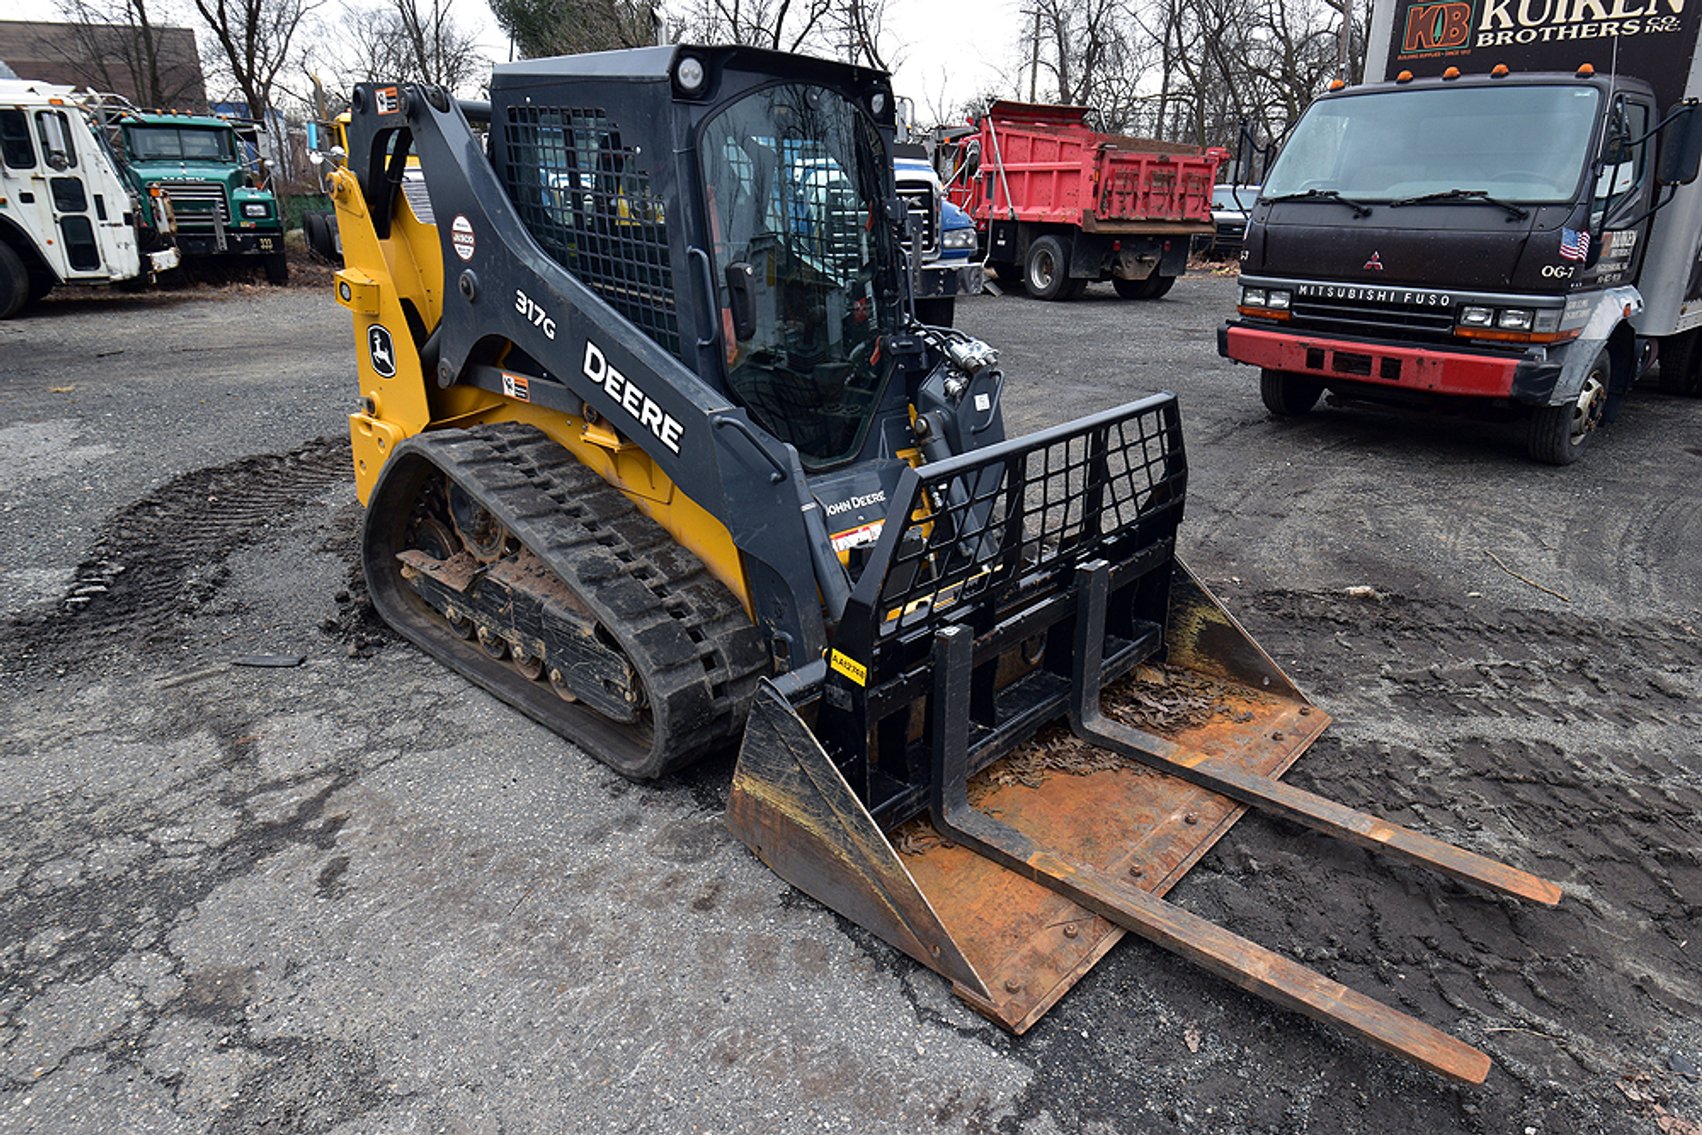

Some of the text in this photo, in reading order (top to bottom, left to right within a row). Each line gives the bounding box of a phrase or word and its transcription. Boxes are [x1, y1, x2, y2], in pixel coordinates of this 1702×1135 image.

[1644, 25, 1682, 33] INC.
[1646, 15, 1681, 26] CO.
[1475, 19, 1641, 47] BROTHERS
[1541, 265, 1575, 279] OG-7
[1298, 284, 1450, 307] MITSUBISHI FUSO
[514, 288, 557, 341] 317G
[582, 339, 686, 459] DEERE
[851, 490, 887, 508] DEERE
